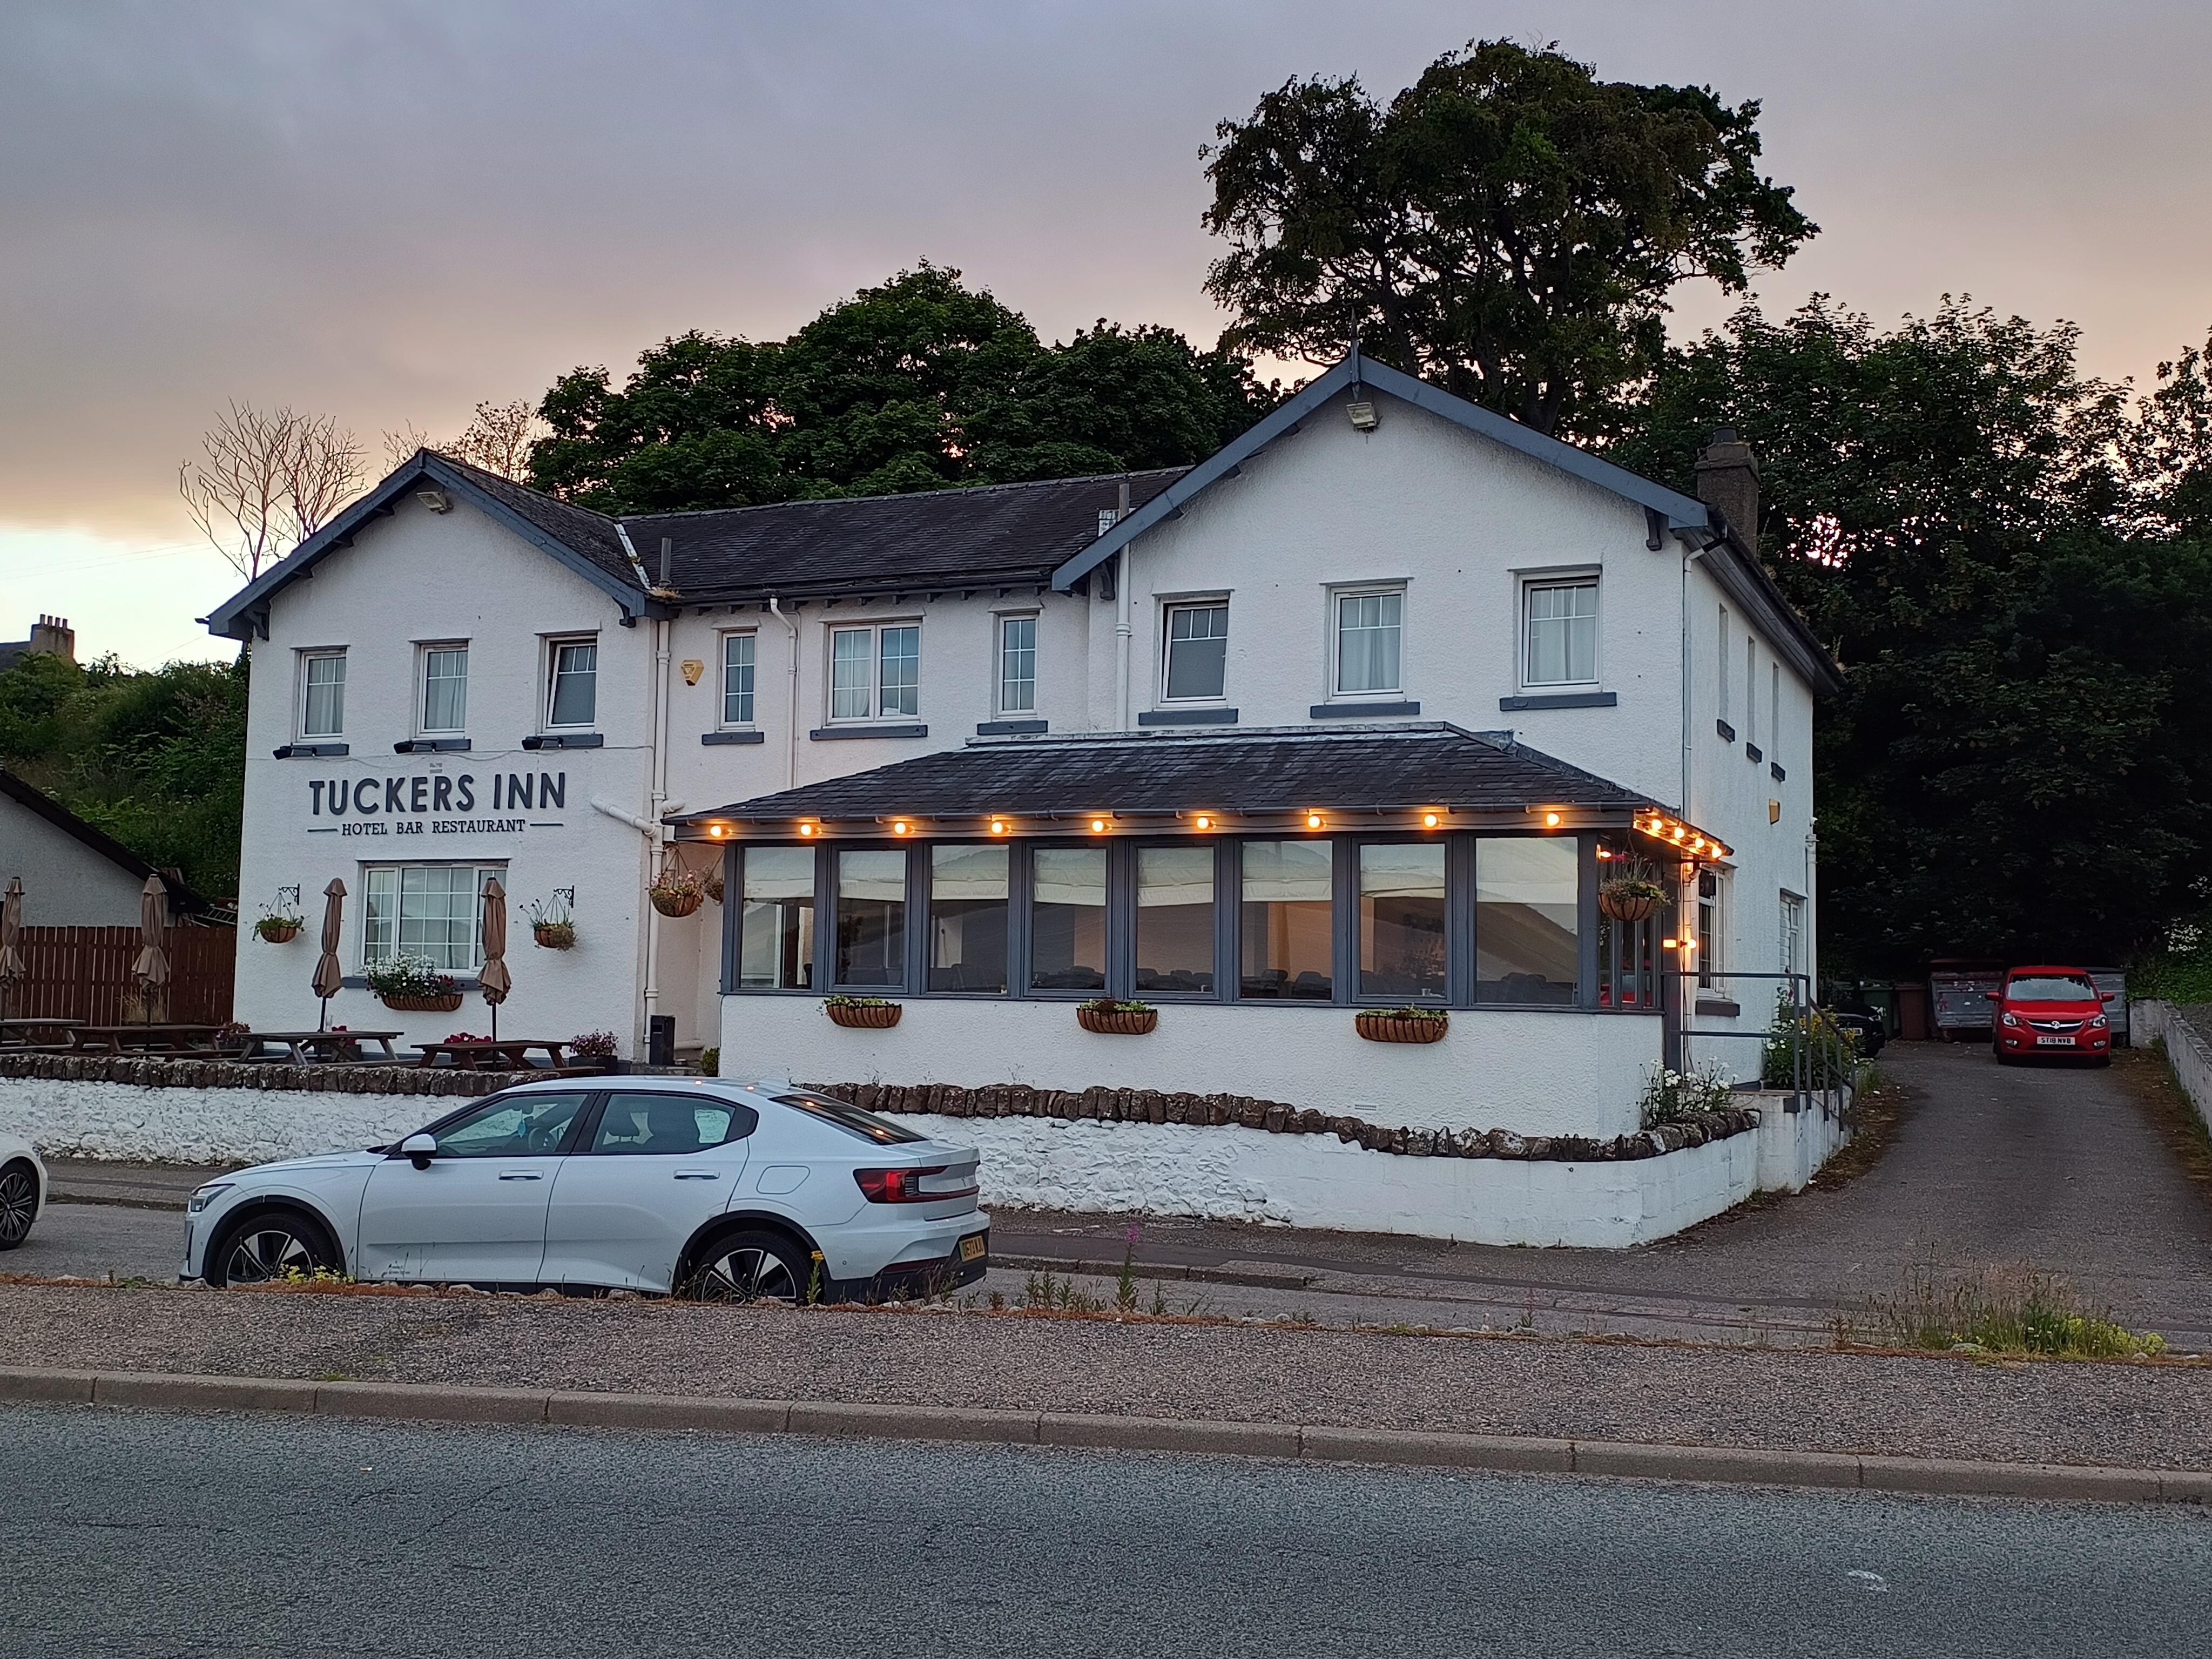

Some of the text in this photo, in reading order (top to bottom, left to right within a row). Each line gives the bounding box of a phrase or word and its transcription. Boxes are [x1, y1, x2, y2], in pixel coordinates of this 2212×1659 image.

[309, 772, 565, 815] TUCKERS INN
[341, 819, 525, 835] HOTEL BAR RESTAURANT
